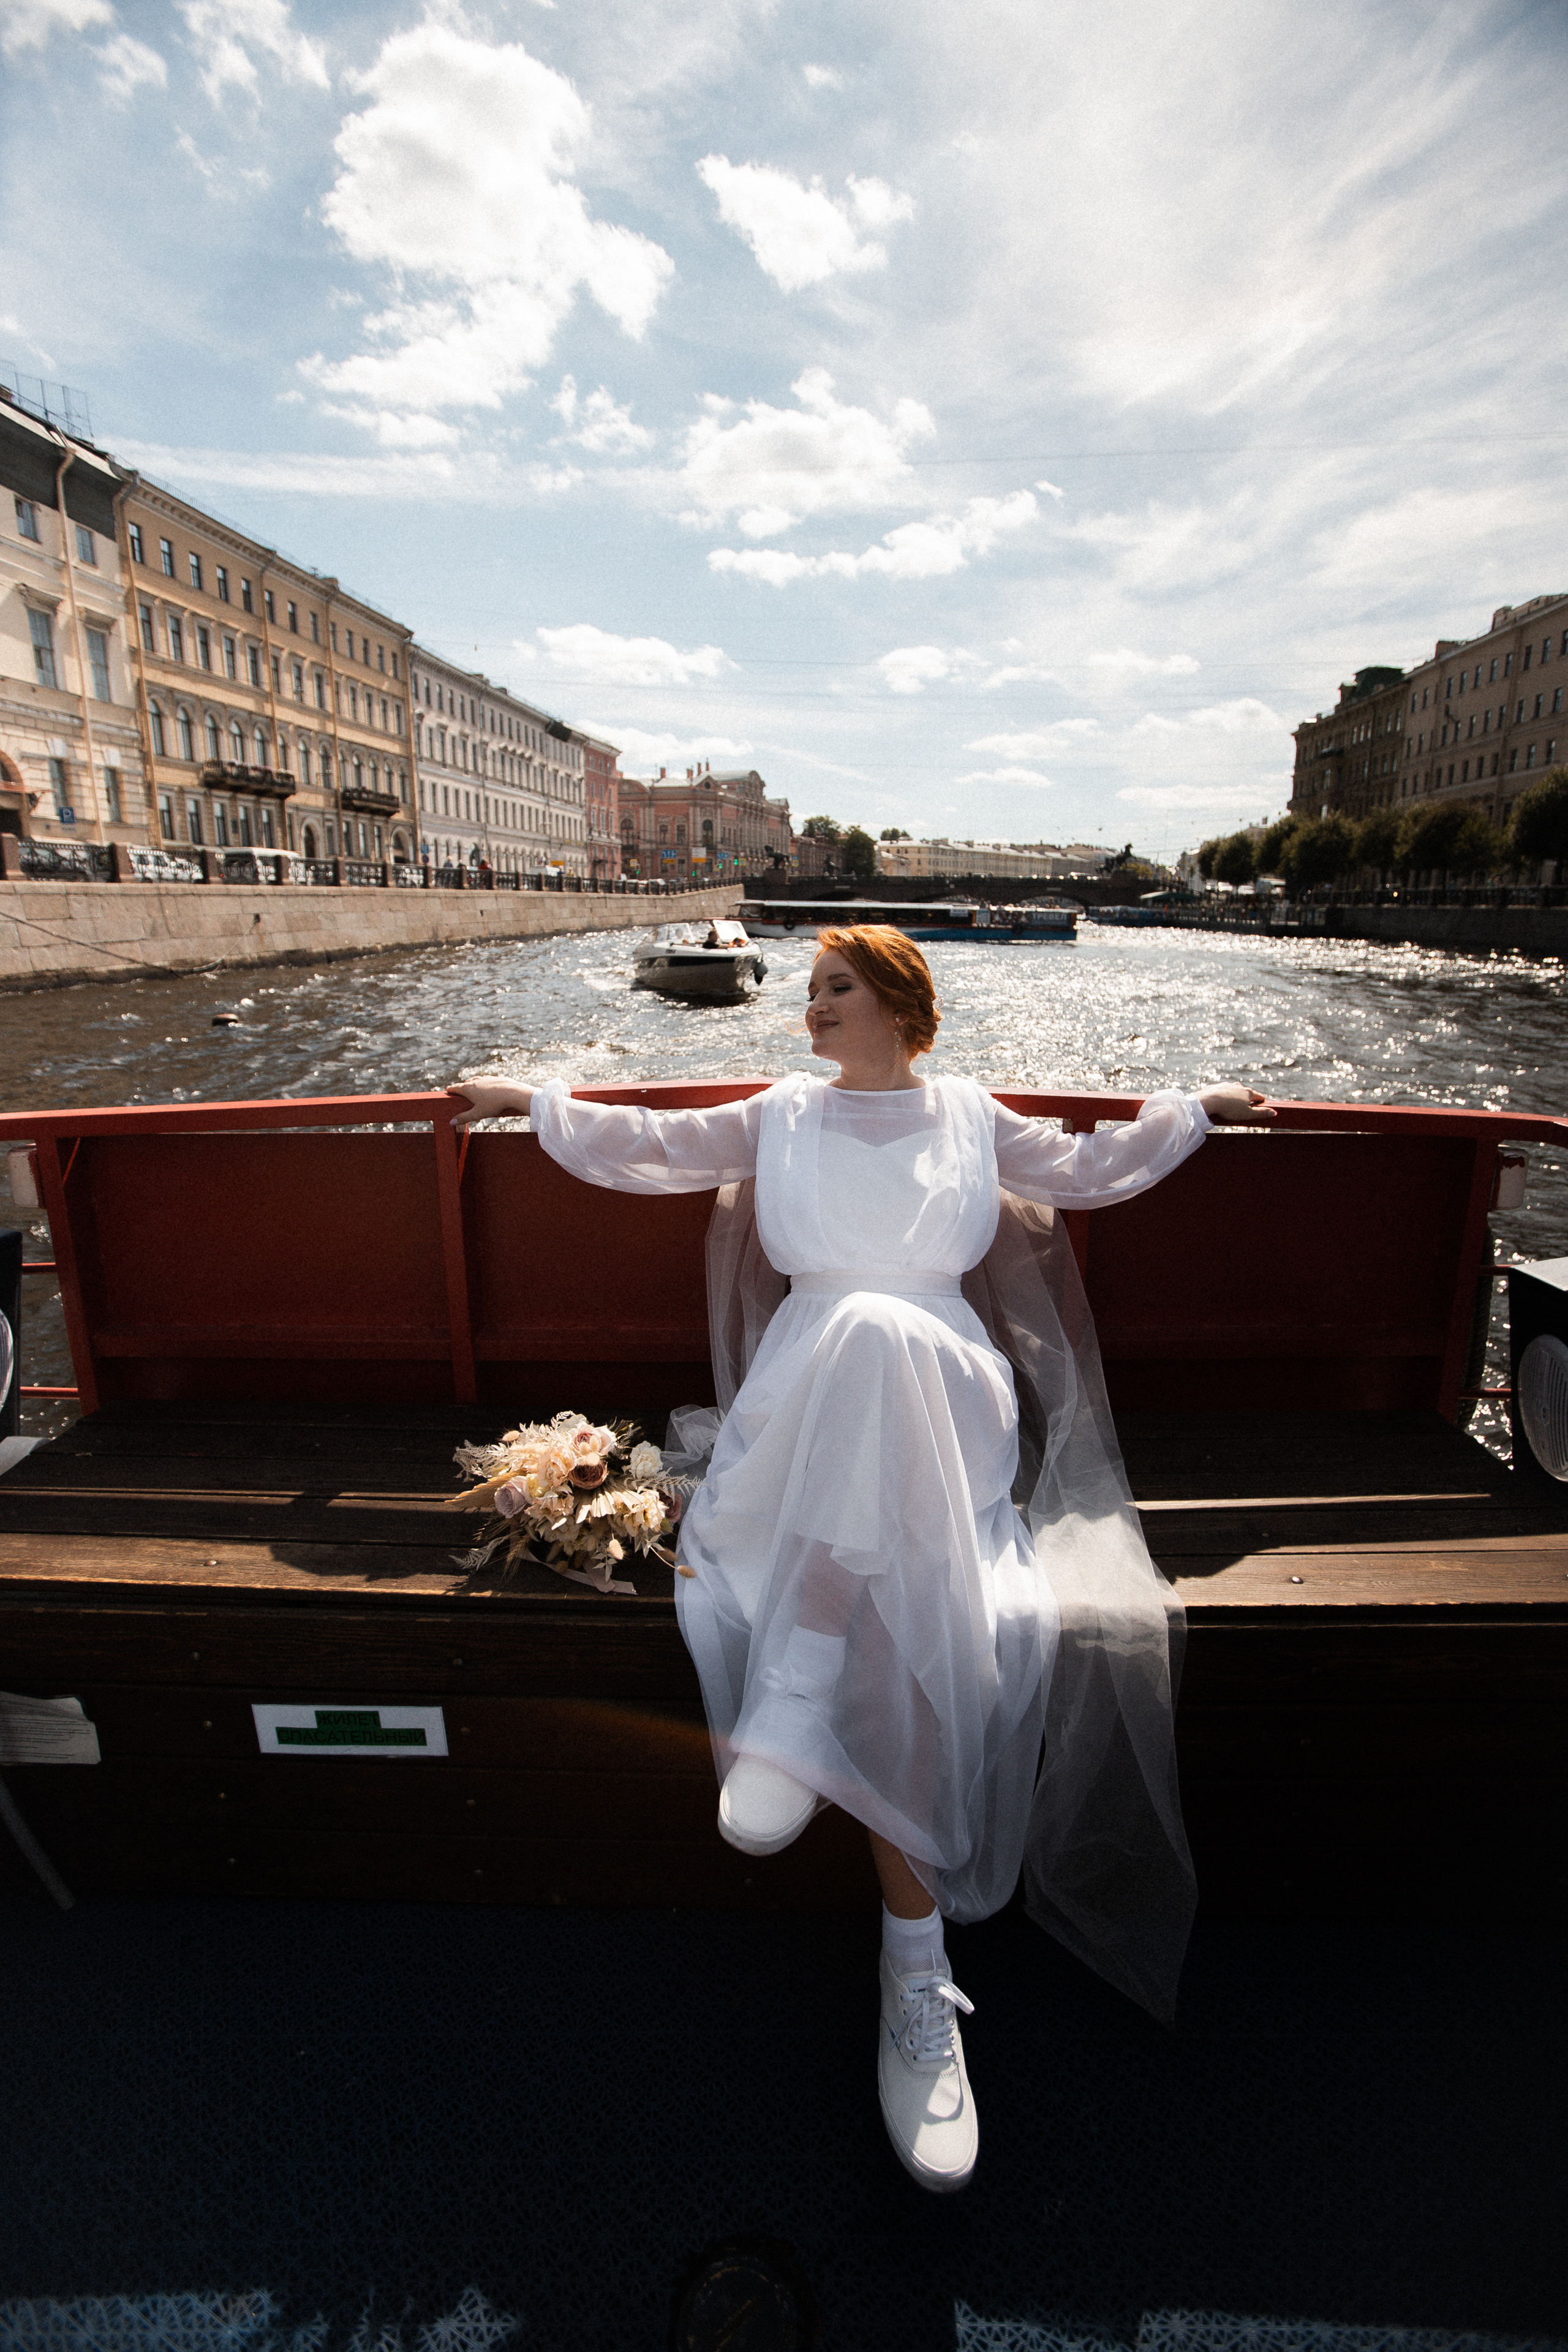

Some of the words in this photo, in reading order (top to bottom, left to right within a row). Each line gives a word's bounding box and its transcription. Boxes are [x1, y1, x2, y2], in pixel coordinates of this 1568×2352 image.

[62, 809, 71, 822] P
[315, 1713, 379, 1725] ЖИЛЕТ
[277, 1729, 426, 1744] СПАСАТЕЛЬНЫЙ
